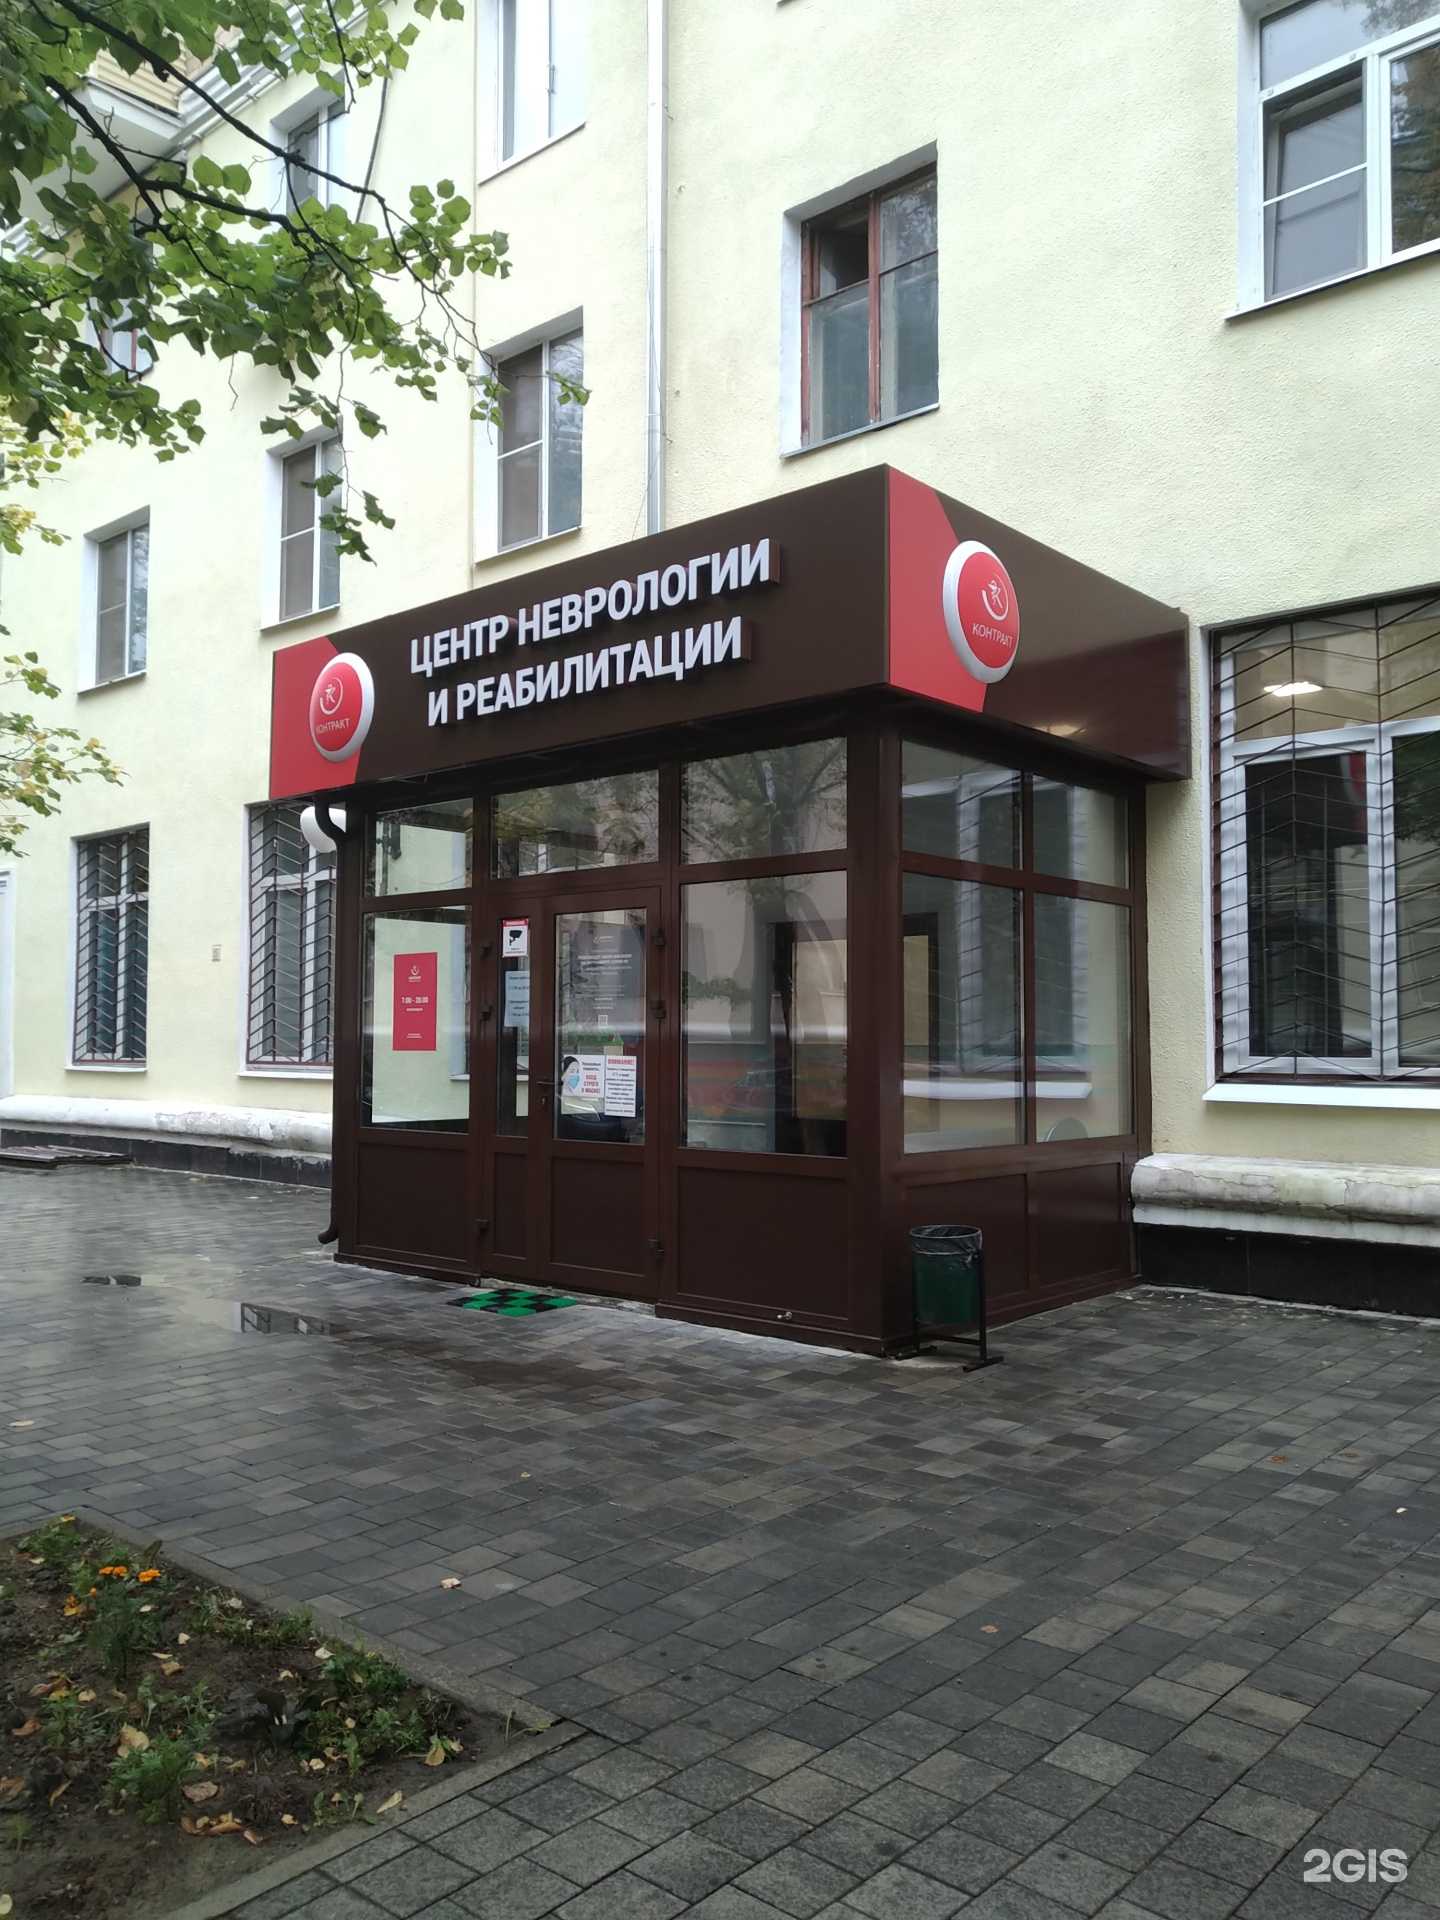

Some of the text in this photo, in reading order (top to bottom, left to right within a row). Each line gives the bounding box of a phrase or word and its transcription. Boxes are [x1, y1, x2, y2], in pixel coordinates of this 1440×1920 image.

[410, 538, 771, 677] ЦЕНТР НЕВРОЛОГИИ
[972, 623, 1013, 648] КОНТРАКТ
[427, 616, 743, 727] И РЕАБИЛИТАЦИИ
